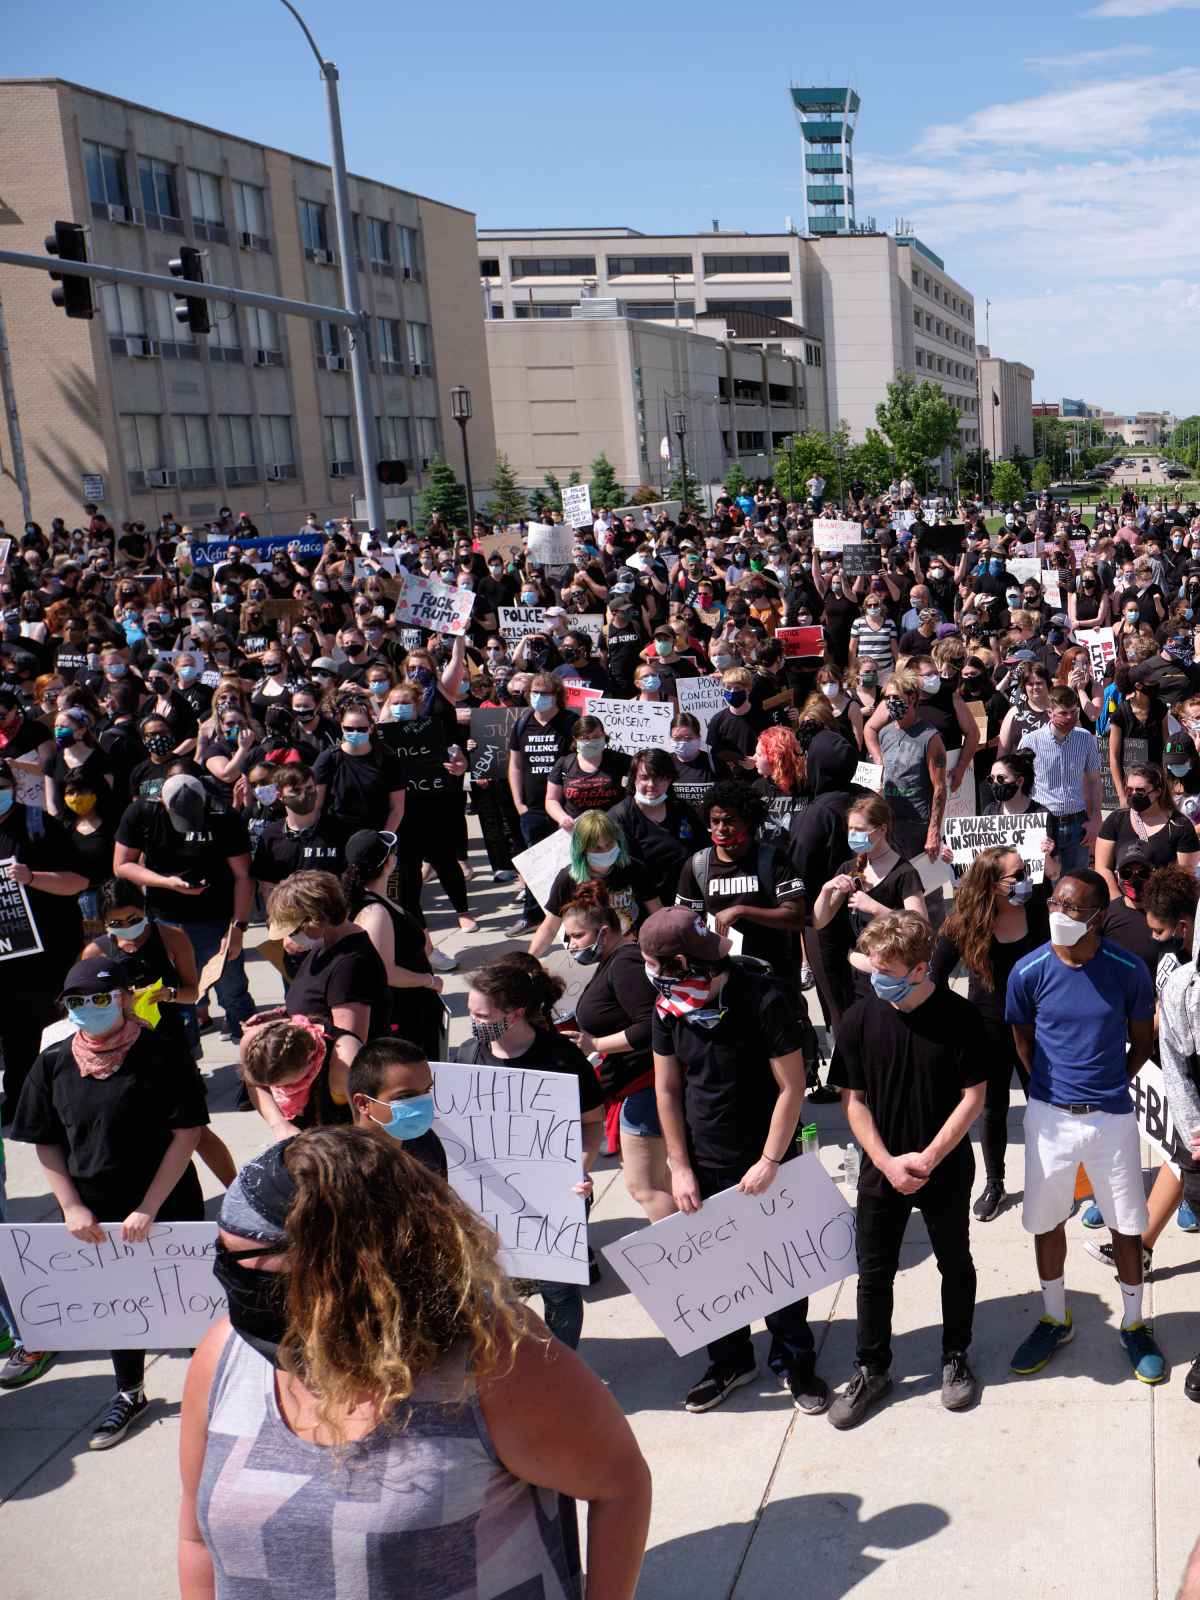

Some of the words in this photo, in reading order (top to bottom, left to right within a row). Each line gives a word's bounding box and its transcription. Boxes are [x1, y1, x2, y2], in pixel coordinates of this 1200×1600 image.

[419, 592, 455, 611] FUCK
[410, 604, 461, 623] TRUMP
[503, 608, 544, 624] POLICE
[587, 700, 644, 715] SILENCE
[652, 706, 671, 718] IS
[527, 735, 555, 744] WHITE
[630, 731, 665, 745] LIVES
[523, 744, 558, 754] SILENCE
[528, 755, 555, 764] COSTS
[945, 818, 956, 834] IF
[958, 817, 977, 833] YOU
[996, 812, 1047, 831] NEUTRAL
[949, 834, 960, 849] IN
[1011, 830, 1025, 845] OF
[709, 875, 759, 896] PUMA
[432, 1070, 557, 1116] WHITE
[1130, 1075, 1178, 1152] #BL
[466, 1171, 527, 1216] IS
[620, 1215, 740, 1287] Protect
[759, 1188, 796, 1217] us
[10, 1226, 105, 1275] Rest
[20, 1284, 155, 1336] George
[672, 1283, 754, 1334] from
